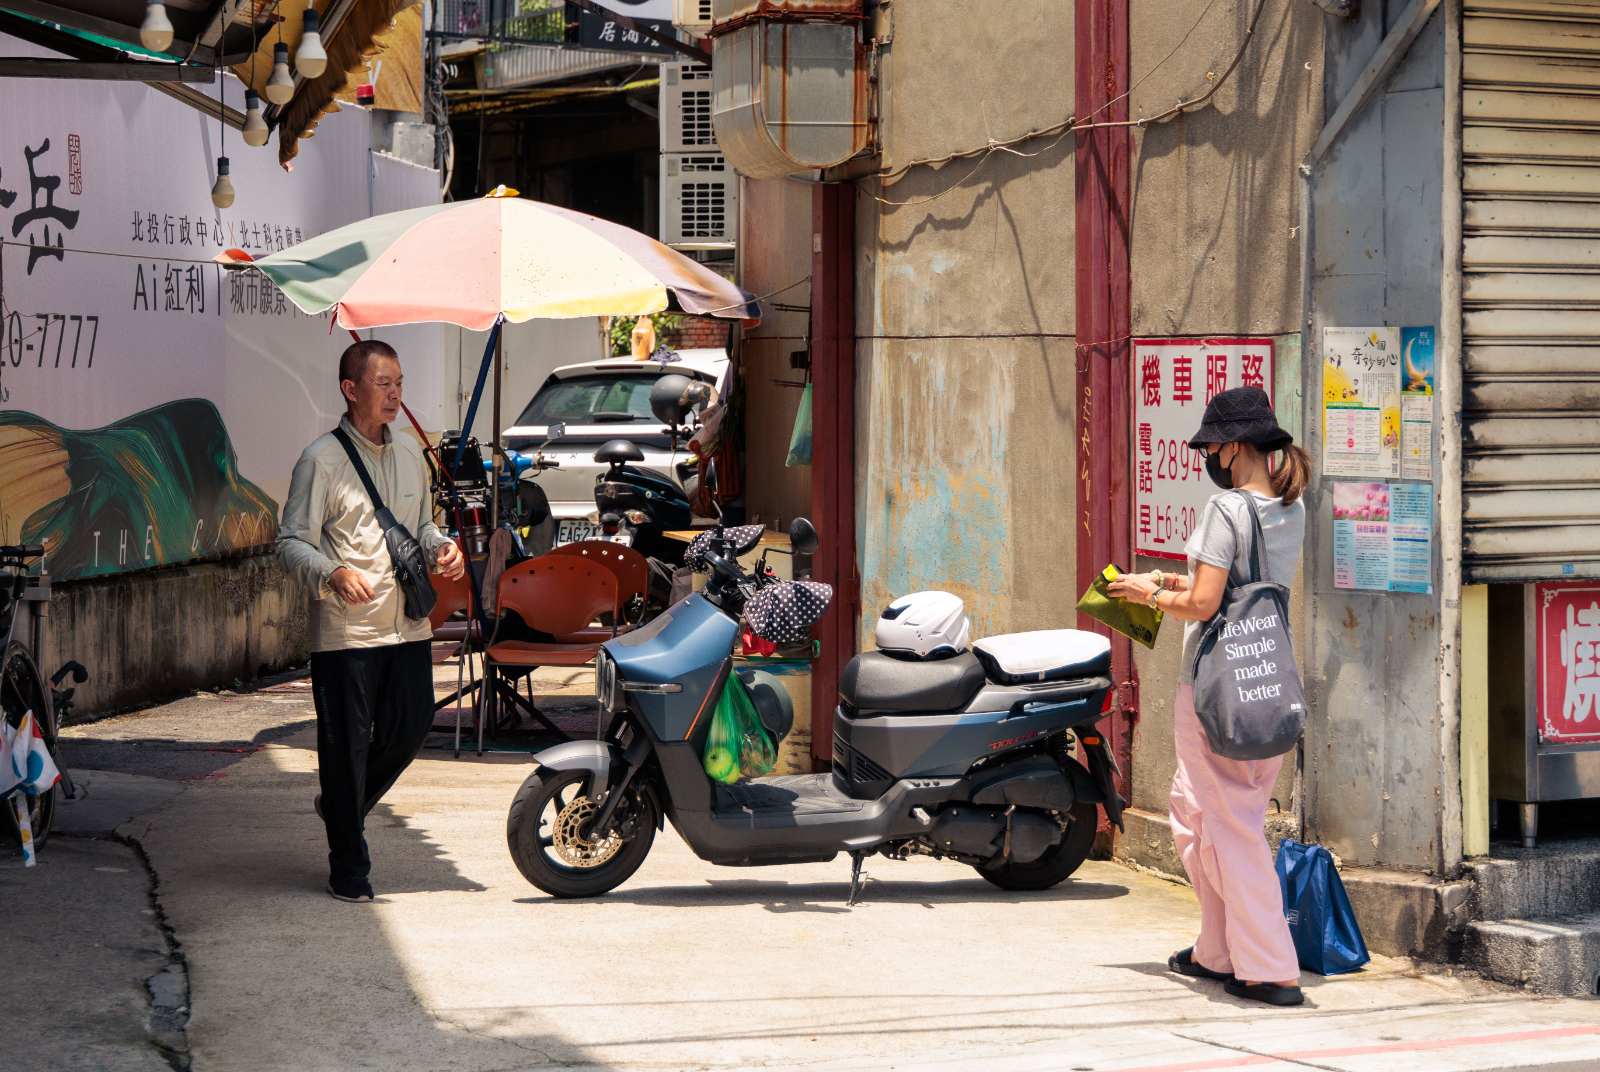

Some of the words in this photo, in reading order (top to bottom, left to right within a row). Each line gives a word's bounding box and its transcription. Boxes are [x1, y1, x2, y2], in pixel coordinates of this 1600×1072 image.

[0, 310, 99, 368] 0-7777
[93, 525, 153, 568] THE
[1225, 637, 1276, 660] Simple
[1234, 659, 1277, 681] made
[1237, 683, 1282, 702] better
